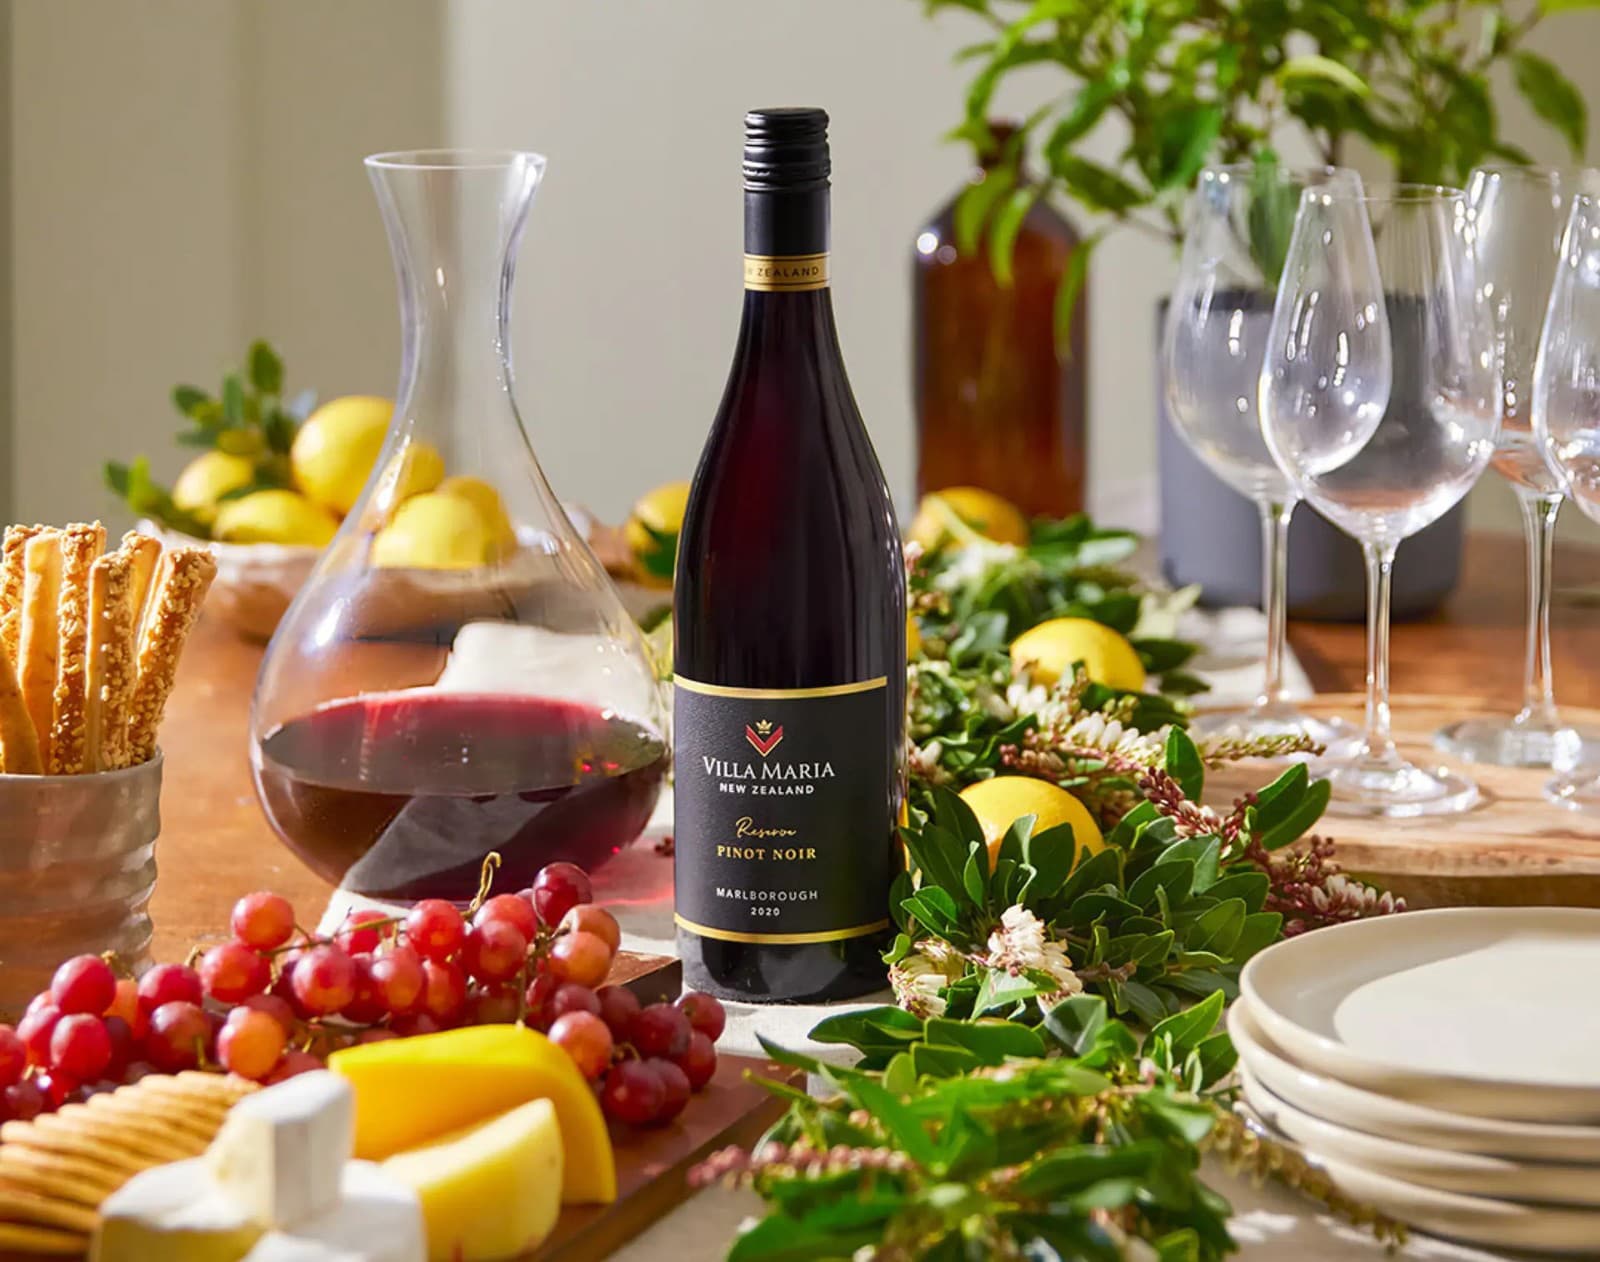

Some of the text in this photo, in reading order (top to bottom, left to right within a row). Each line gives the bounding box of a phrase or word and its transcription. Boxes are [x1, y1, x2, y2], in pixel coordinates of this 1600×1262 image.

[757, 266, 820, 278] ZEALAND
[719, 782, 815, 795] NEW ZEALAND
[735, 816, 797, 839] Reserve
[716, 845, 817, 860] PINOT NOIR
[715, 887, 818, 901] MARLBOROUGH
[750, 907, 780, 917] 2020
